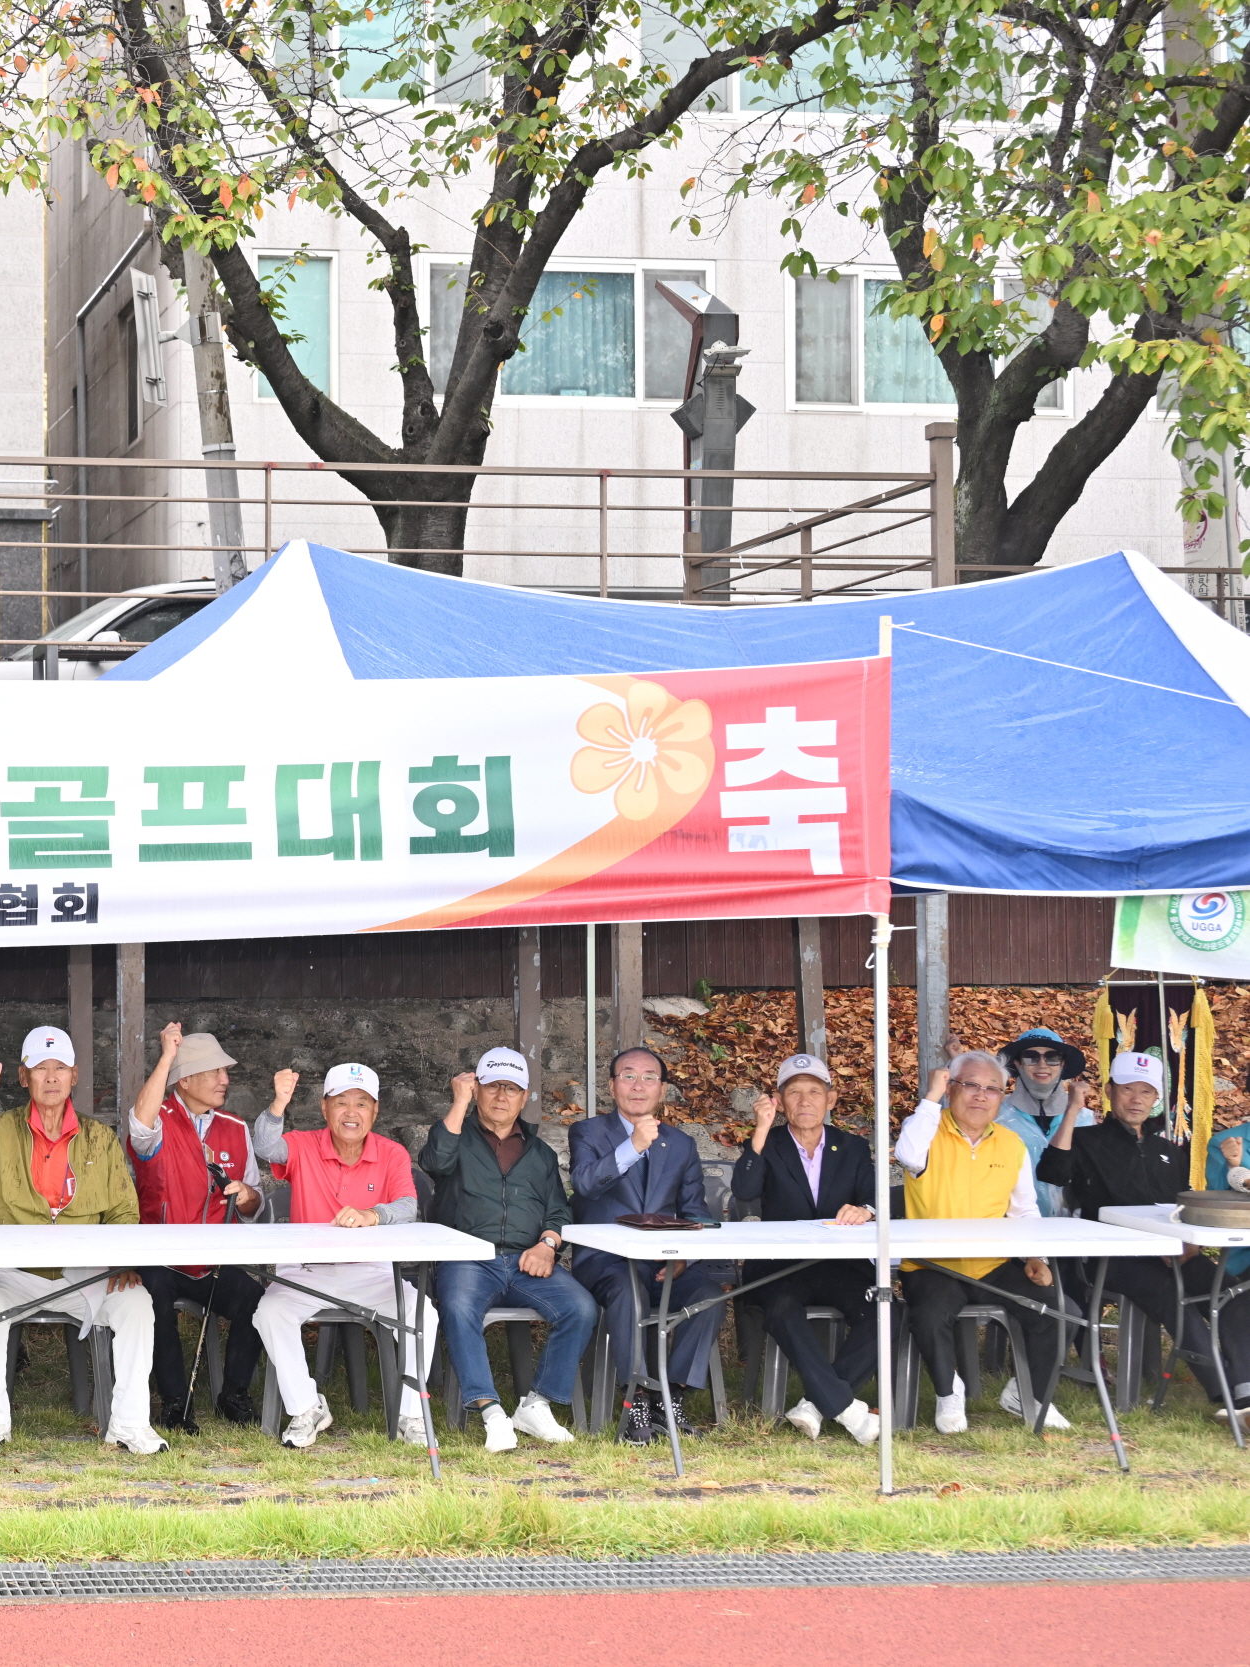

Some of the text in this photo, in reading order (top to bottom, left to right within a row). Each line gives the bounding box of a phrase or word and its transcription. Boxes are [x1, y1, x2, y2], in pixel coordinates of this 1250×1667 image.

[720, 706, 848, 876] 축
[1191, 921, 1223, 933] UGGA
[486, 1060, 524, 1072] TaylorMade
